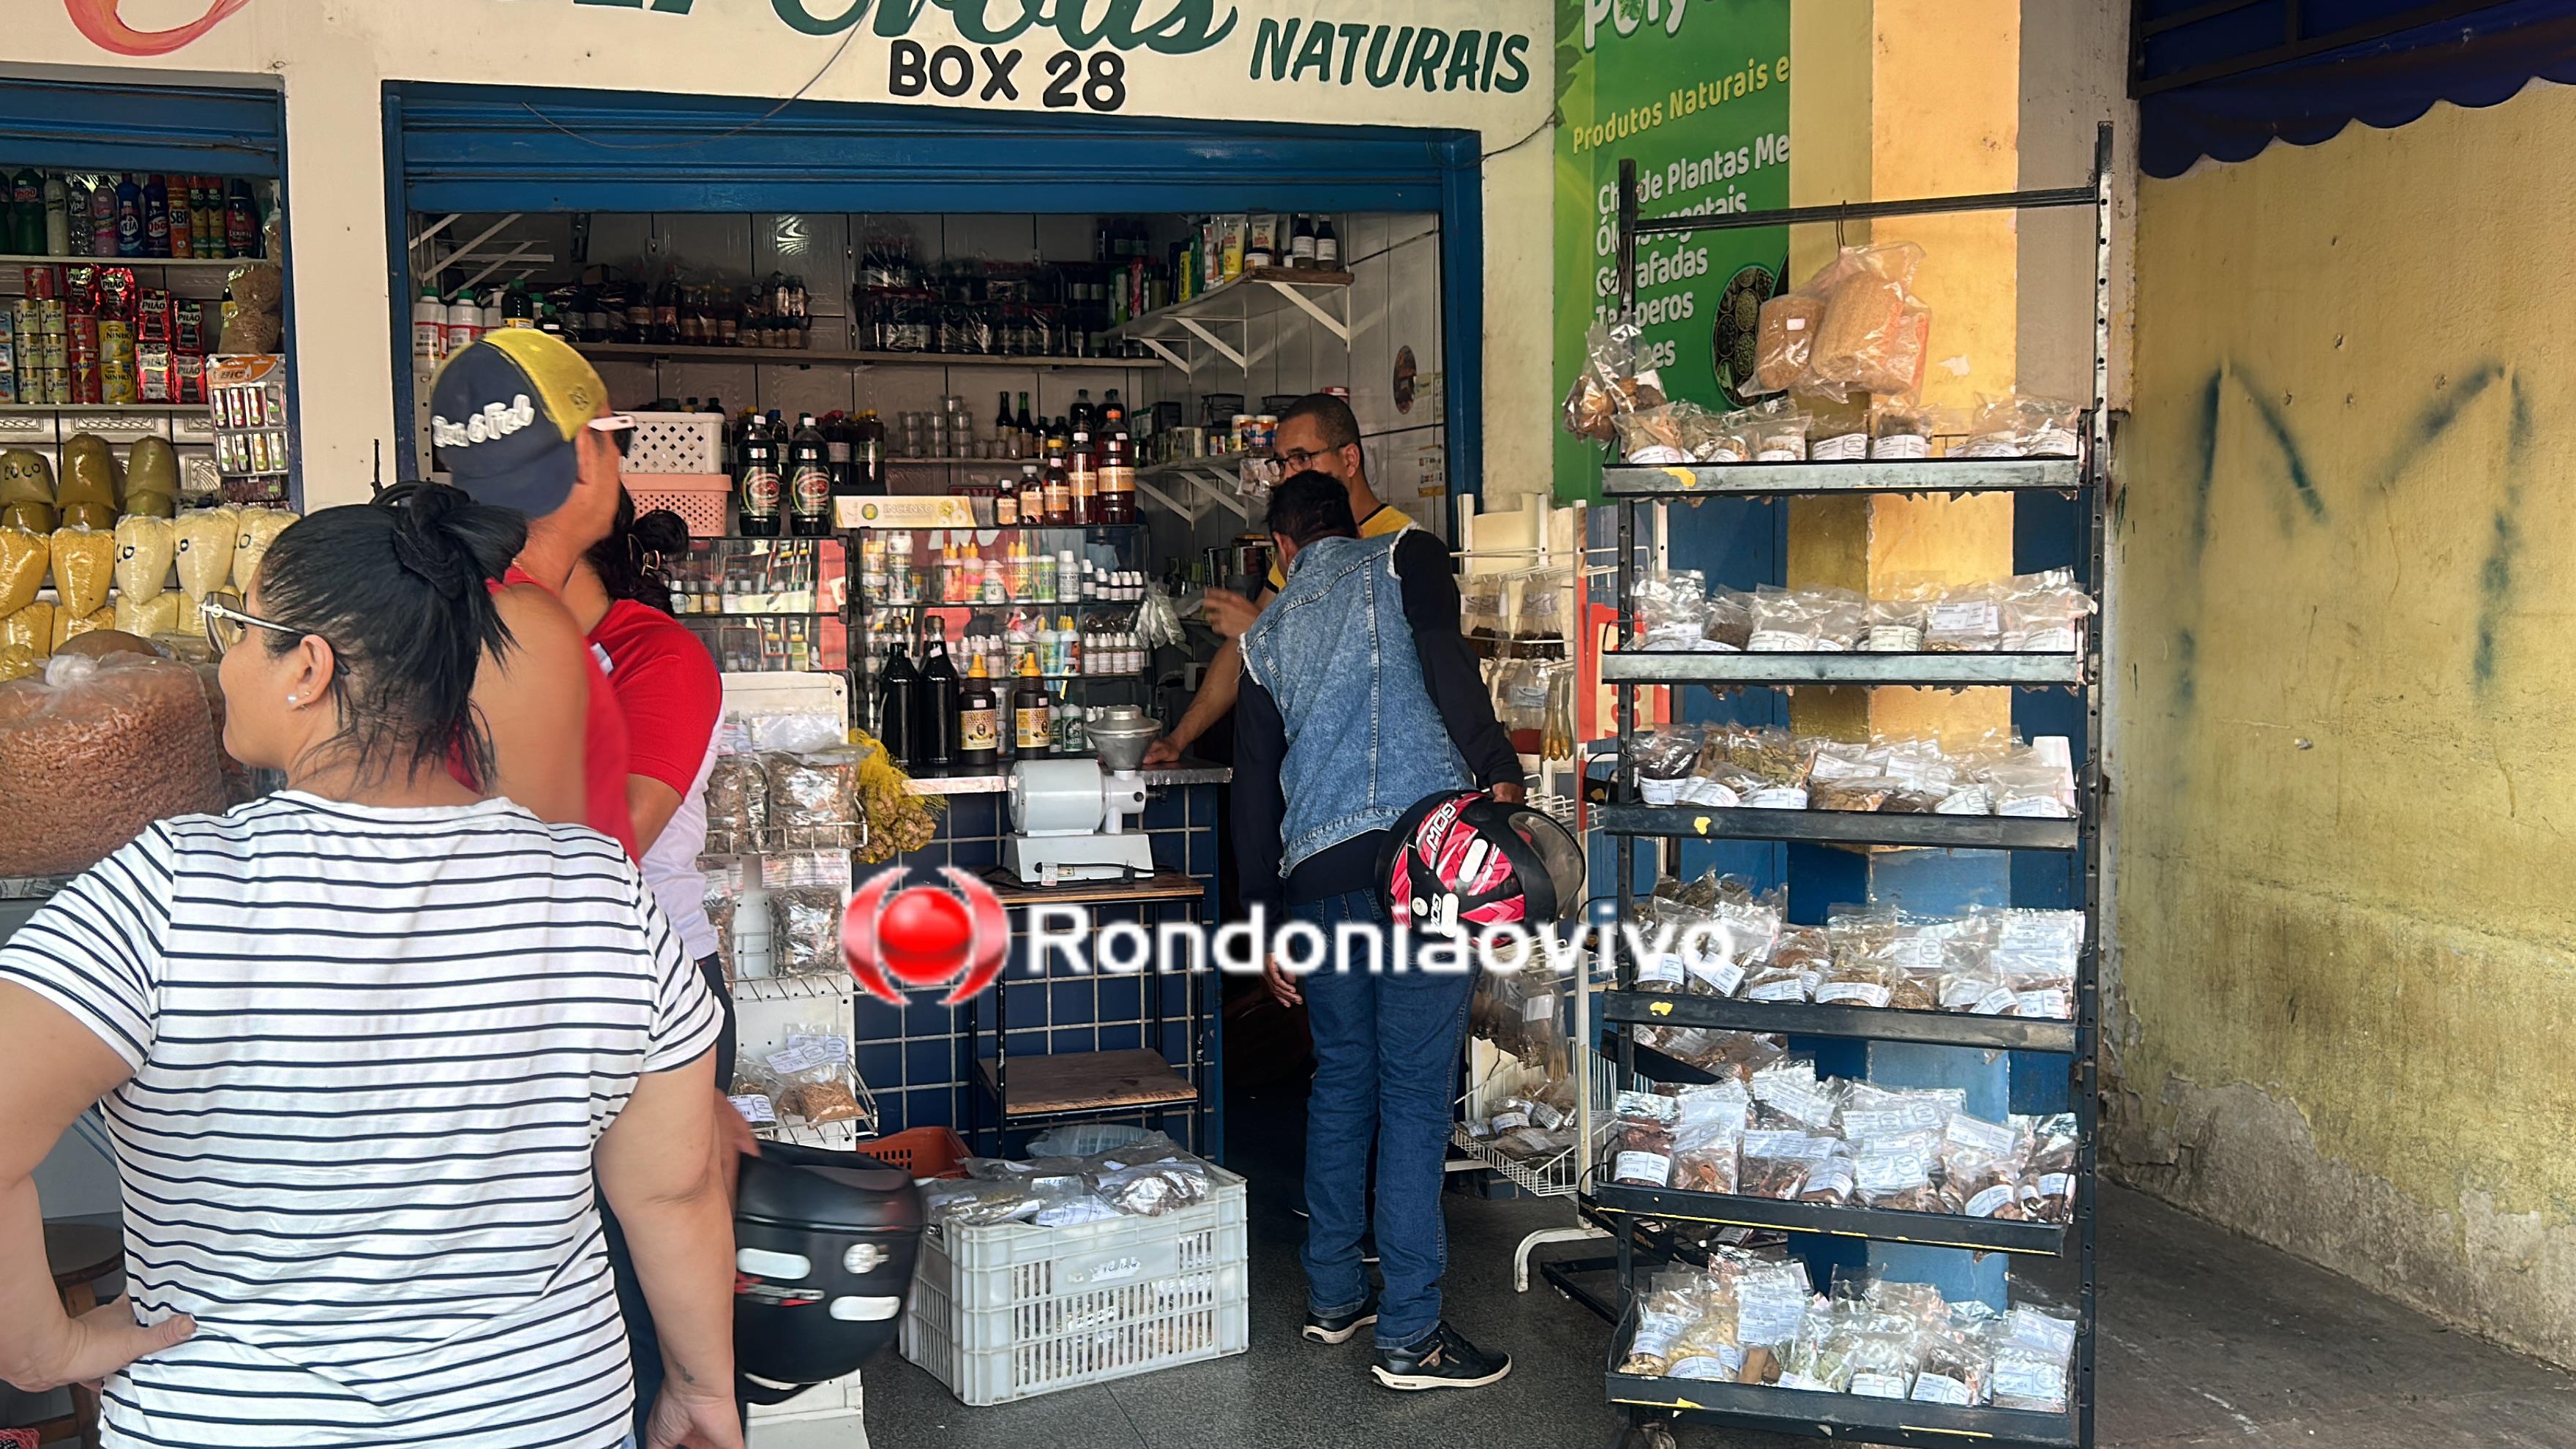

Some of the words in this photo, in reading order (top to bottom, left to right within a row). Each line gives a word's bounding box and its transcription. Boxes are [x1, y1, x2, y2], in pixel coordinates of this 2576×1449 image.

[888, 40, 1022, 102] BOX
[1042, 50, 1126, 112] 28
[1249, 18, 1530, 94] NATURAIS
[1573, 102, 1663, 154] Produtos
[1669, 59, 1767, 120] Naturais
[1775, 56, 1790, 83] e
[1668, 146, 1749, 194] Plantas
[1596, 245, 1708, 297] Gaafadas
[1595, 291, 1694, 329] Teperos
